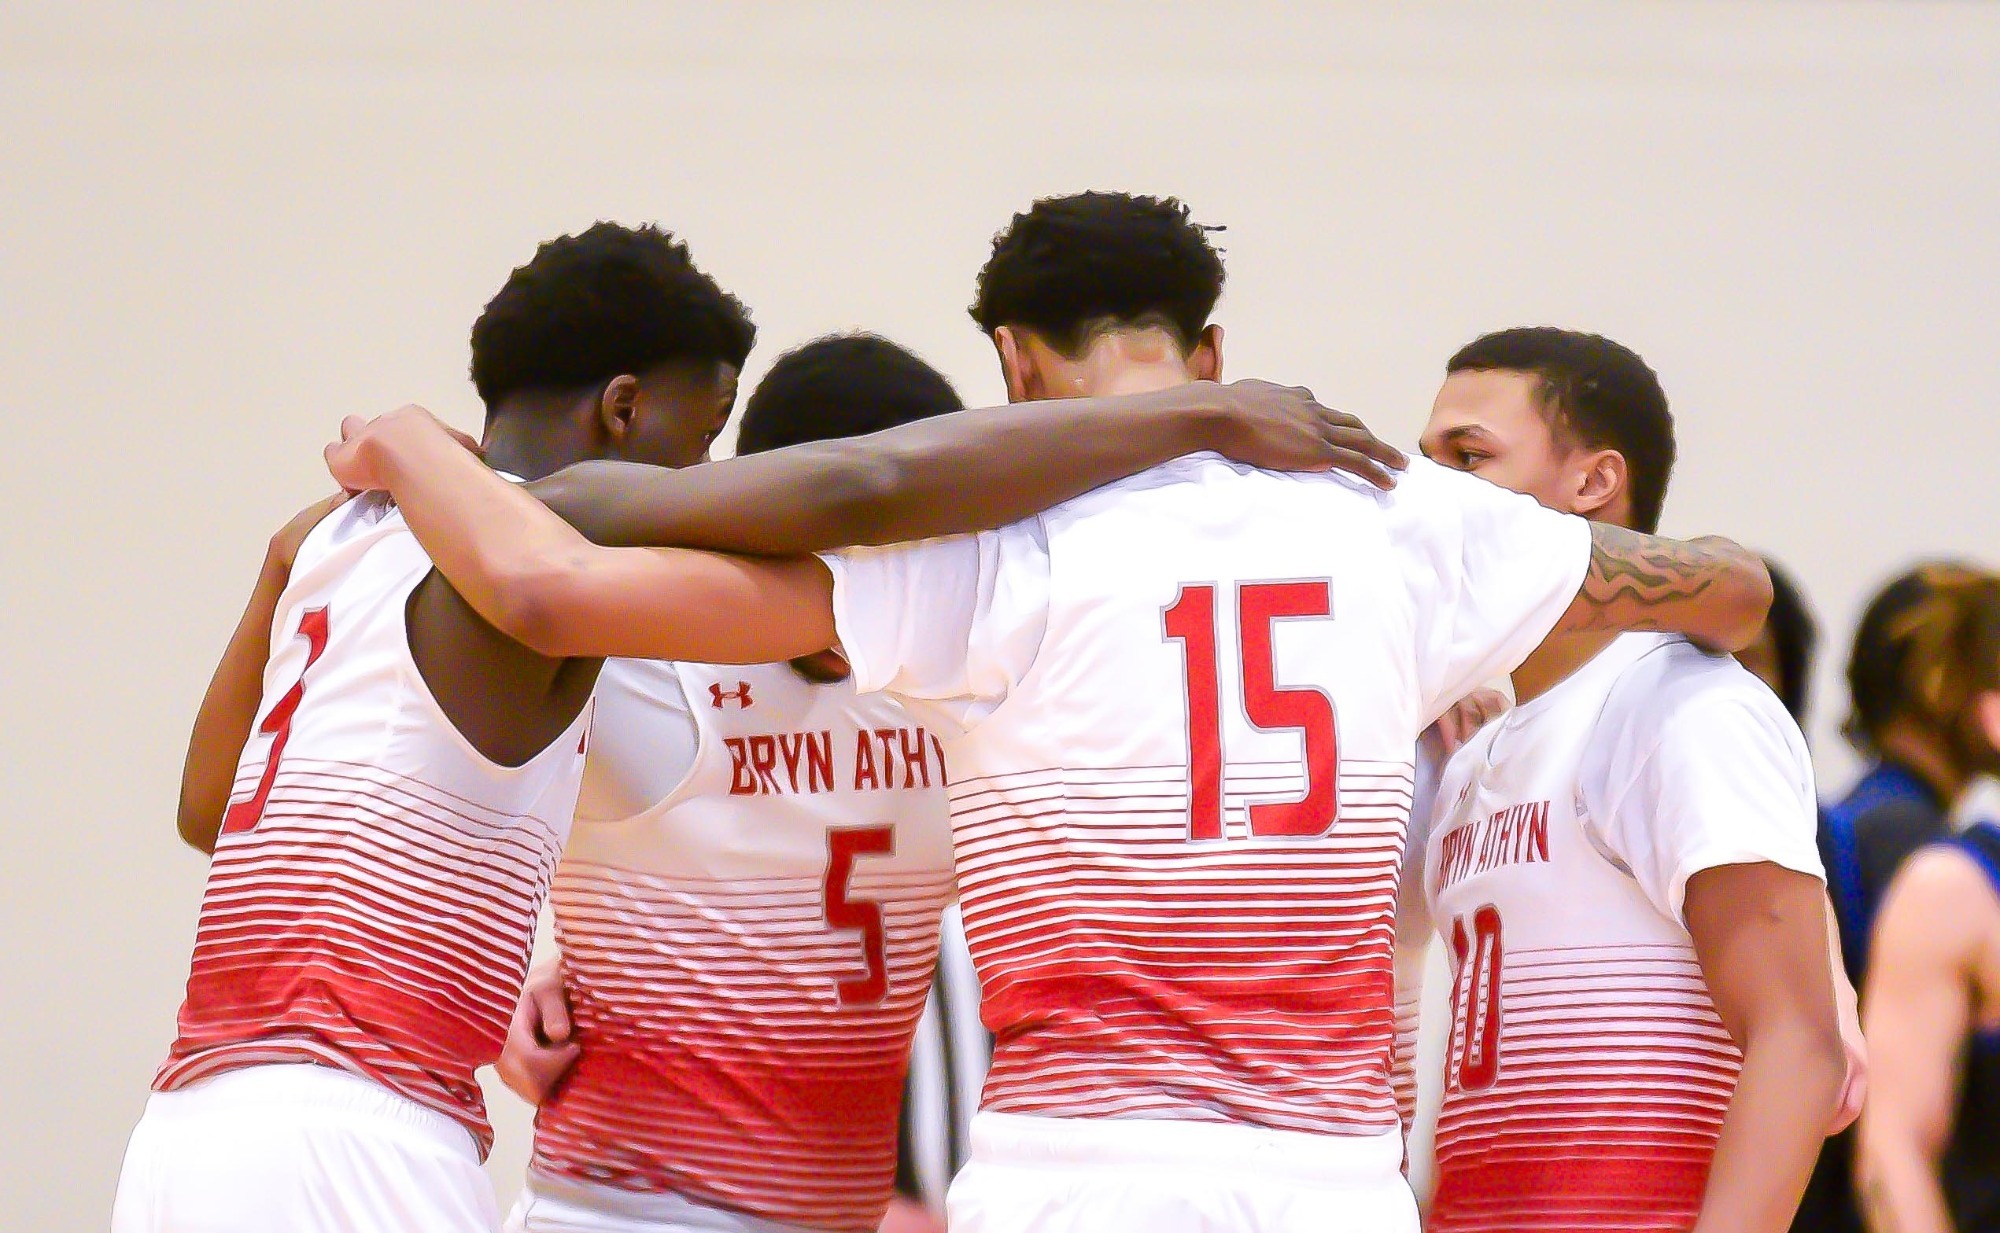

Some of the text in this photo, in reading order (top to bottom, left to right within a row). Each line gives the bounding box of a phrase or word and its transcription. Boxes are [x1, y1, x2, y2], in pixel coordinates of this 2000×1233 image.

[723, 729, 835, 796] BRYN
[1160, 577, 1342, 842] 15
[824, 824, 895, 1008] 5
[1474, 801, 1550, 874] ATHYN
[1444, 905, 1503, 1091] 10
